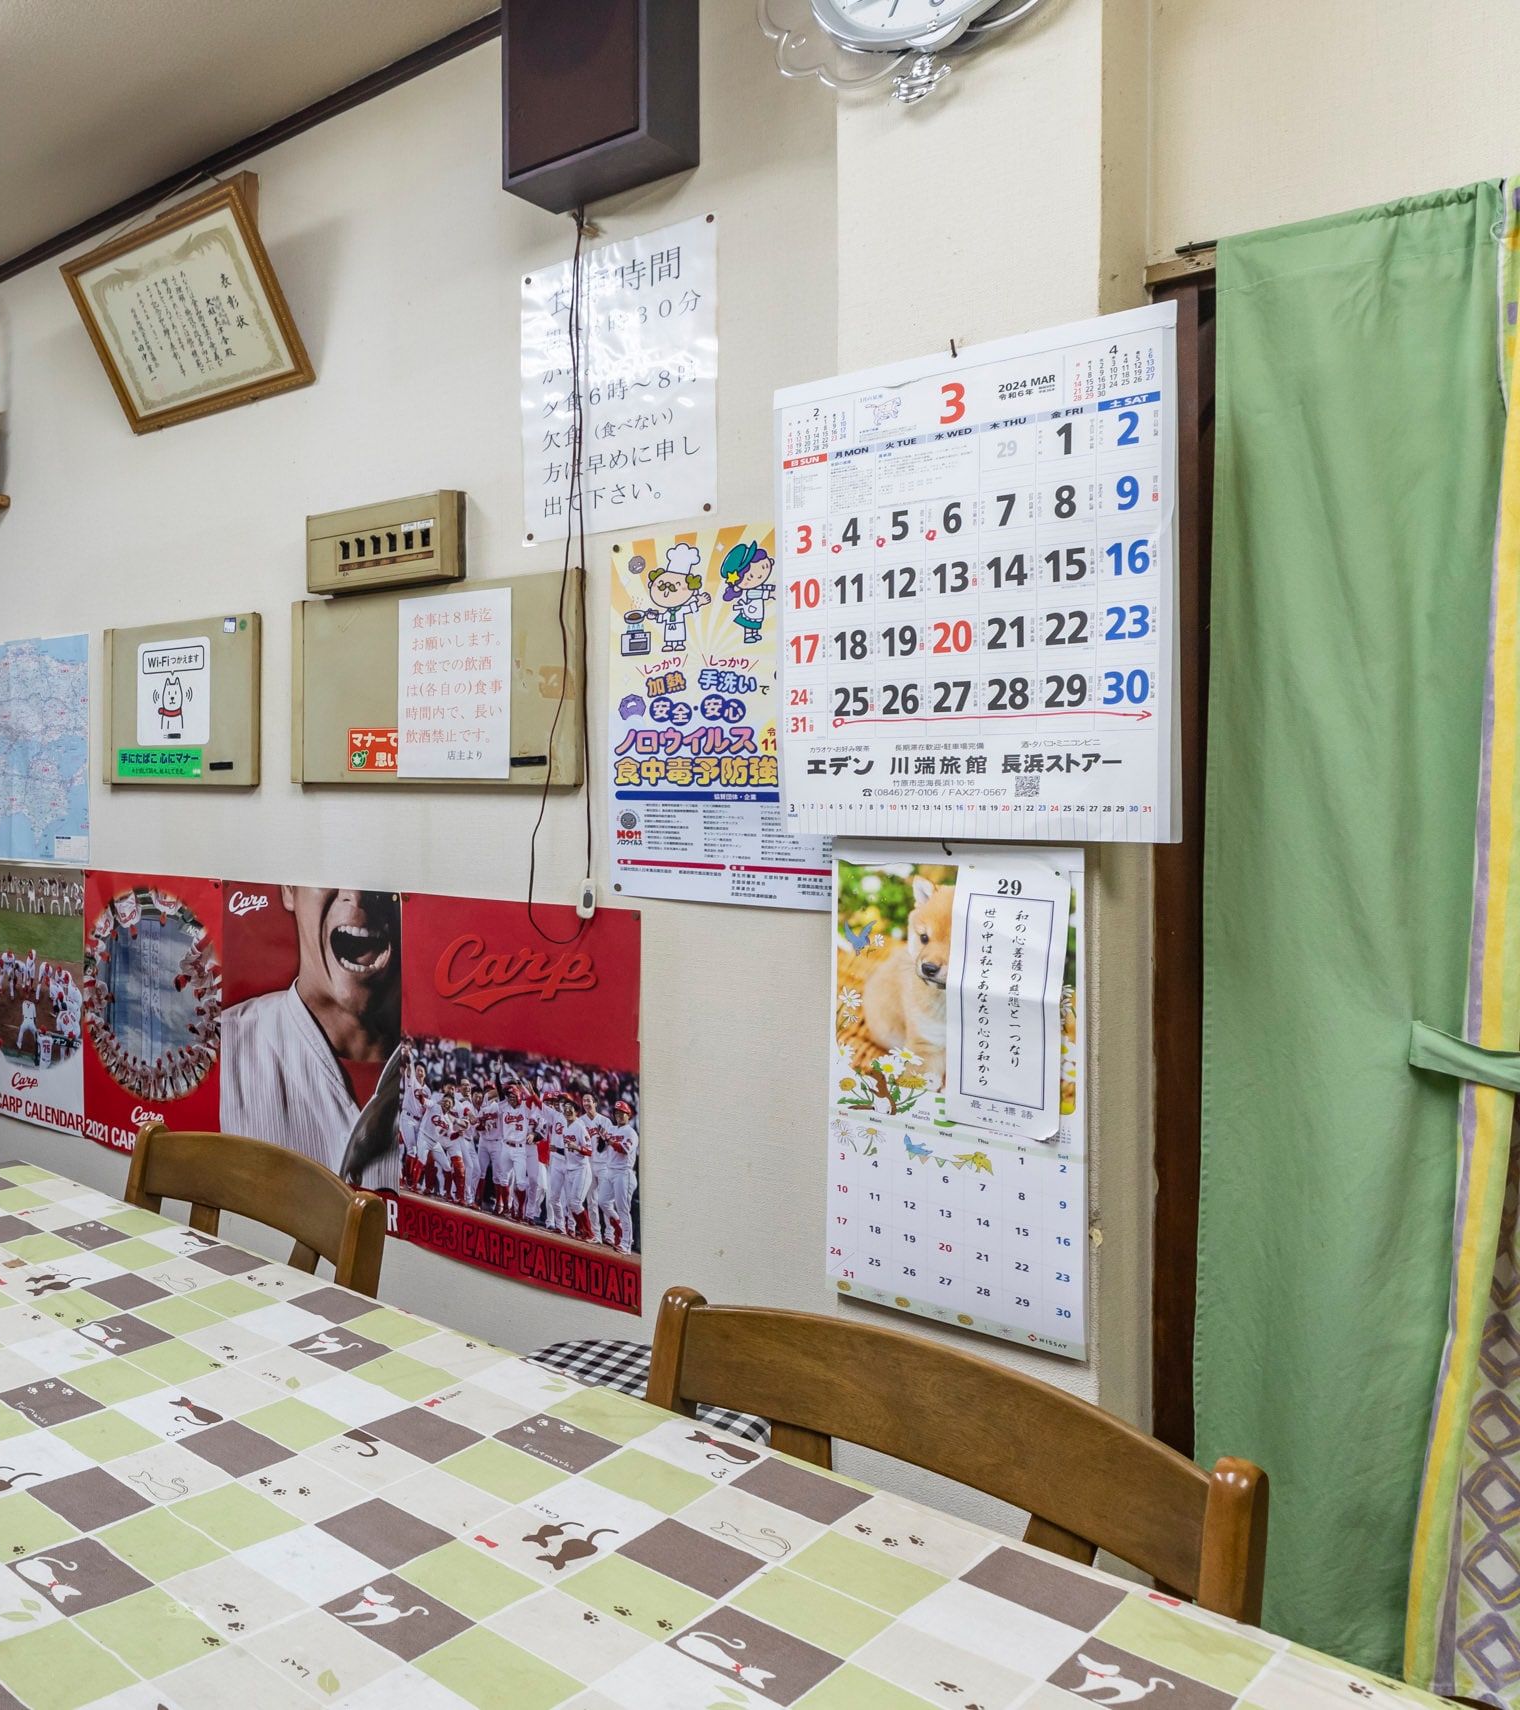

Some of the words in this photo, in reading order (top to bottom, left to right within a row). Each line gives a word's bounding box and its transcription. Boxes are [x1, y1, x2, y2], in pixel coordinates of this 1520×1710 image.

[1109, 344, 1118, 355] 4
[998, 380, 1027, 394] 2024
[1031, 373, 1056, 387] MAR
[939, 382, 966, 425] 3
[998, 388, 1034, 401] 令和6年
[1109, 400, 1122, 409] 土
[1123, 394, 1149, 405] SAT
[813, 408, 820, 417] 2
[1051, 410, 1062, 419] 金
[1065, 407, 1084, 417] FRI
[989, 421, 1000, 430] 木
[1002, 417, 1027, 427] THU
[885, 441, 895, 449] 火
[896, 438, 917, 447] TUE
[934, 432, 944, 441] 水
[946, 428, 972, 438] WED
[997, 440, 1017, 459] 29
[1055, 422, 1073, 456] 1
[1116, 411, 1140, 448] 2
[543, 435, 701, 485] 方は早めに申し
[800, 455, 820, 466] SUN
[844, 446, 869, 459] MON
[543, 482, 662, 519] 出て下さい。
[795, 525, 813, 555] 3
[841, 517, 861, 548] 4
[891, 509, 910, 541] 5
[942, 501, 962, 535] 6
[996, 493, 1017, 528] 7
[1053, 485, 1077, 520] 8
[1115, 475, 1141, 511] 9
[789, 578, 820, 610] 10
[834, 573, 865, 605] 11
[881, 567, 918, 600] 12
[933, 561, 969, 594] 13
[986, 554, 1028, 590] 14
[1044, 547, 1087, 584] 15
[1105, 539, 1151, 578] 16
[411, 632, 501, 651] お願いします。
[789, 633, 820, 665] 17
[834, 630, 868, 661] 18
[881, 625, 918, 657] 19
[932, 620, 973, 655] 20
[986, 616, 1026, 650] 21
[1044, 610, 1089, 646] 22
[1104, 604, 1151, 641] 23
[411, 655, 493, 675] 食堂での飲酒
[643, 656, 682, 675] しっかり
[709, 655, 750, 669] しっかり
[646, 671, 687, 698] 加熱
[790, 688, 809, 707] 24
[834, 687, 869, 718] 25
[881, 684, 919, 716] 26
[933, 681, 972, 713] 27
[987, 676, 1030, 711] 28
[1044, 674, 1088, 709] 29
[1102, 669, 1150, 706] 30
[405, 703, 503, 721] 時間内で、長い
[790, 716, 808, 734] 31
[405, 727, 492, 745] 飲酒禁止です。
[614, 727, 757, 756] ノロウイルス
[446, 750, 484, 762] 店主より
[807, 755, 875, 777] エデン
[890, 755, 988, 776] 川端旅館
[1001, 753, 1123, 775] 長浜ストアー
[997, 879, 1022, 896] 29
[228, 890, 270, 916] Carp
[433, 933, 599, 1014] Carp
[11, 1071, 39, 1091] Carp
[24, 1100, 85, 1132] CALENDAR
[85, 1118, 109, 1143] 2021
[939, 1130, 953, 1138] Wed
[1057, 1153, 1069, 1161] Sat
[837, 1185, 848, 1193] 10
[869, 1192, 881, 1201] 11
[904, 1201, 916, 1210] 12
[939, 1209, 952, 1219] 13
[976, 1218, 990, 1227] 14
[1015, 1227, 1029, 1237] 15
[1056, 1236, 1071, 1247] 16
[403, 1202, 459, 1251] 2023
[461, 1223, 516, 1270] CARP
[519, 1242, 640, 1308] CALENDAR
[711, 1468, 731, 1479] Cat
